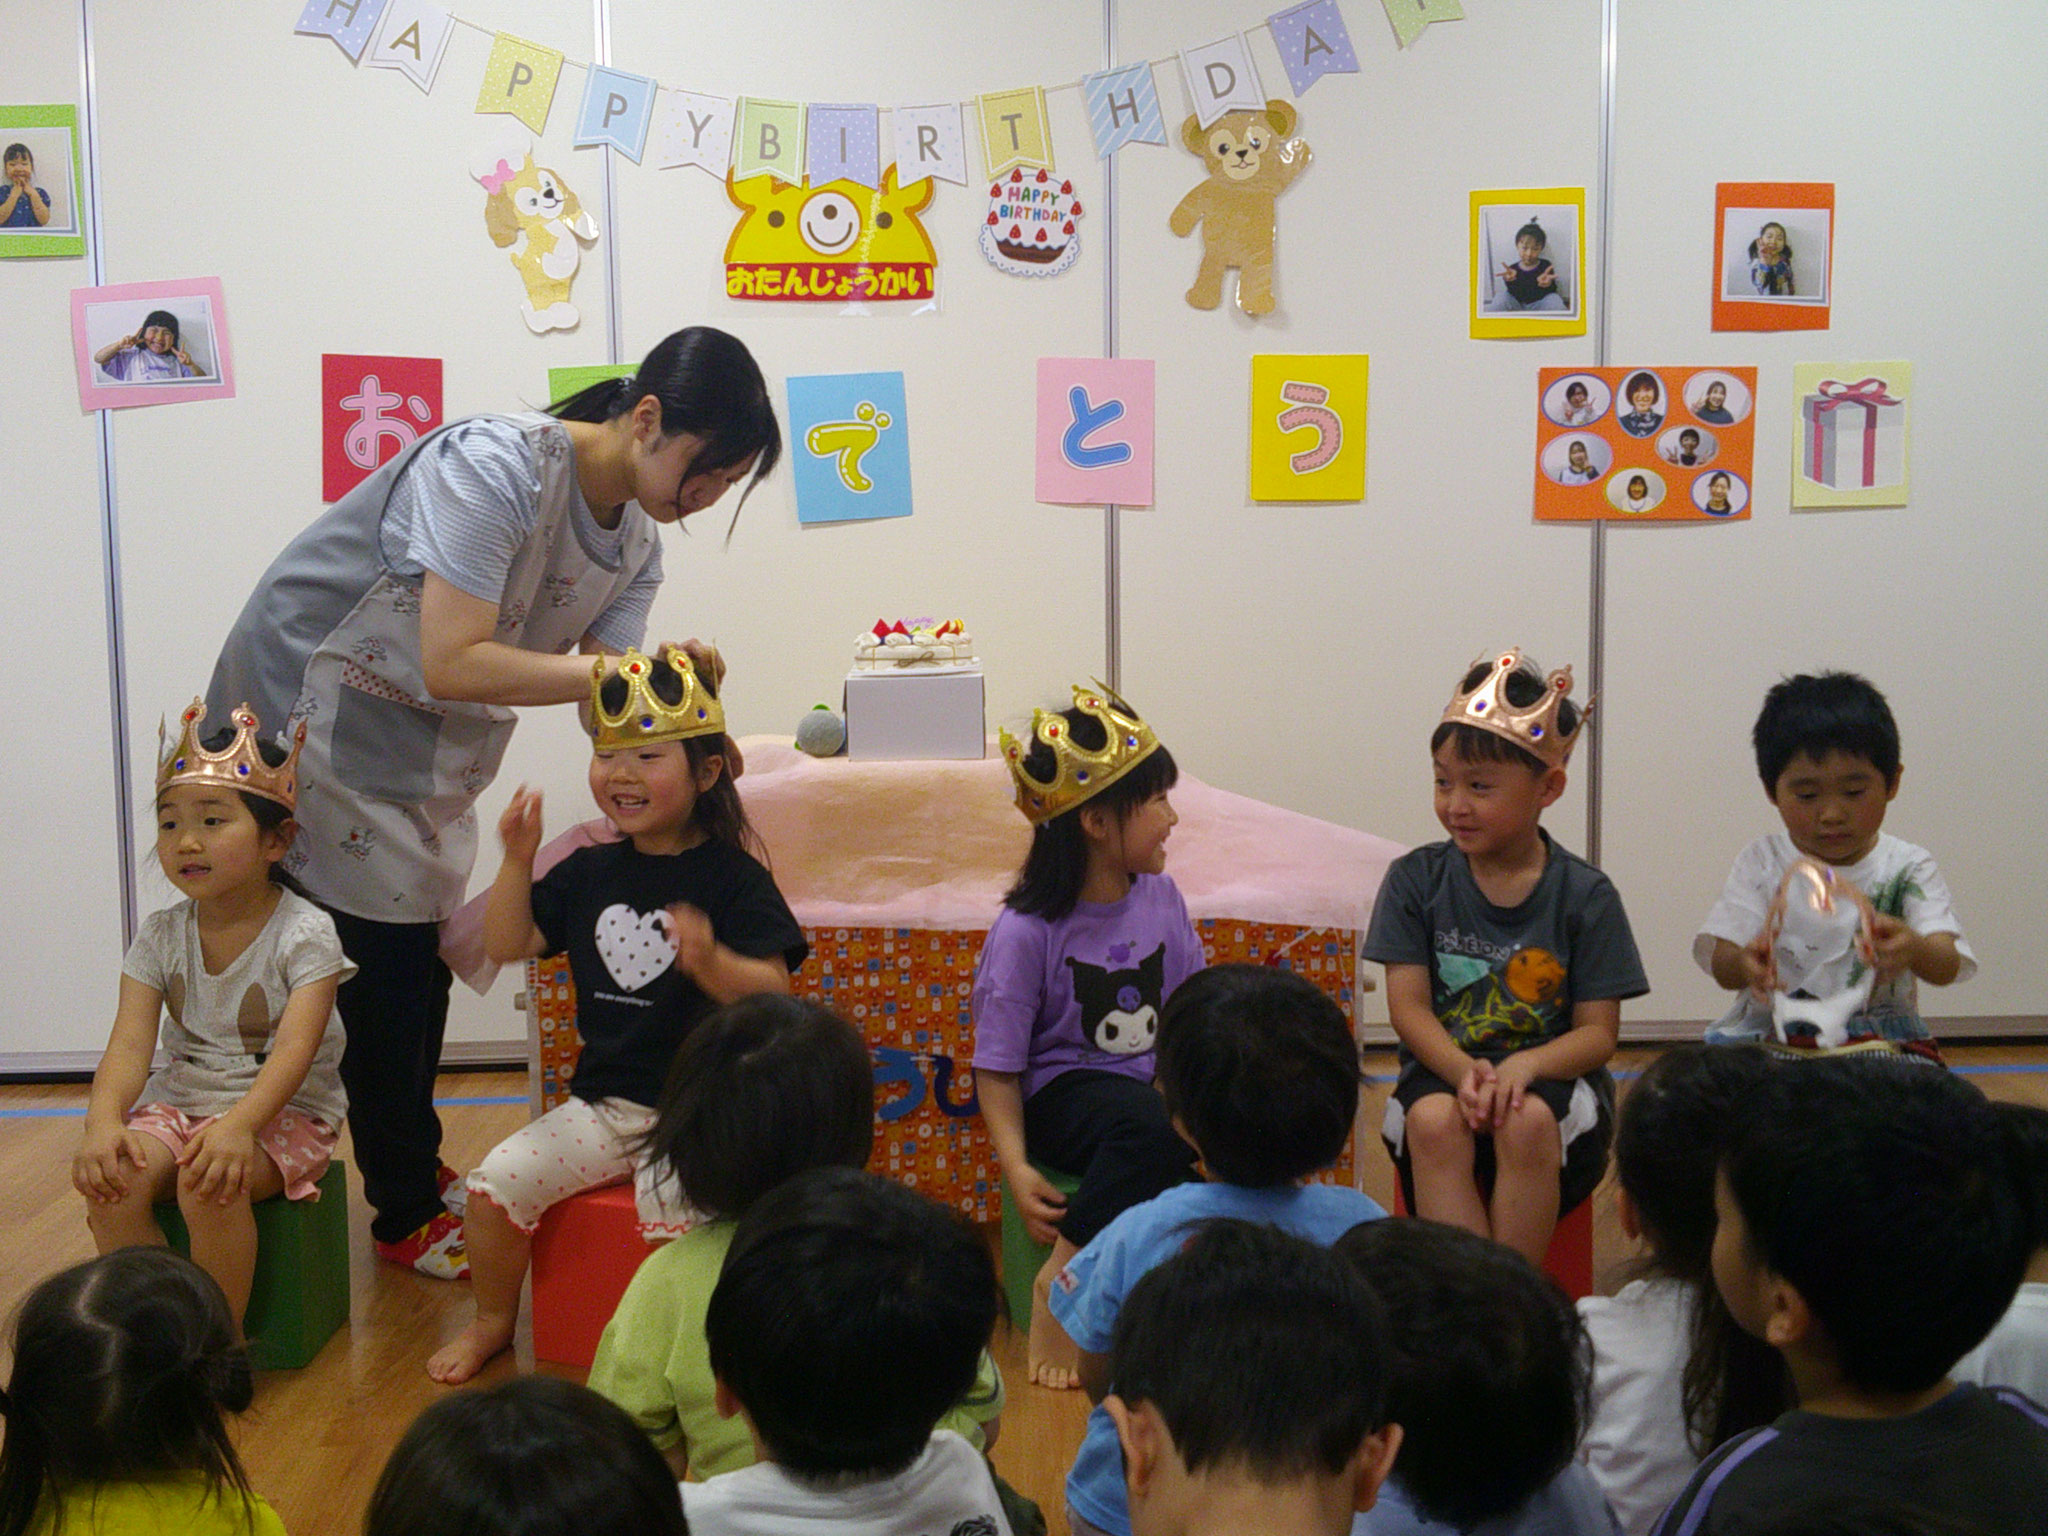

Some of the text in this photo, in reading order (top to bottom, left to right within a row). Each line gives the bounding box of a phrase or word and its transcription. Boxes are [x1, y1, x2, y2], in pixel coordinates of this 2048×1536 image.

[759, 0, 1427, 164] BIRTHDA
[1008, 186, 1060, 206] HAPPY
[1000, 204, 1067, 222] BIRTHDAY
[727, 266, 934, 297] おたんじょうかい
